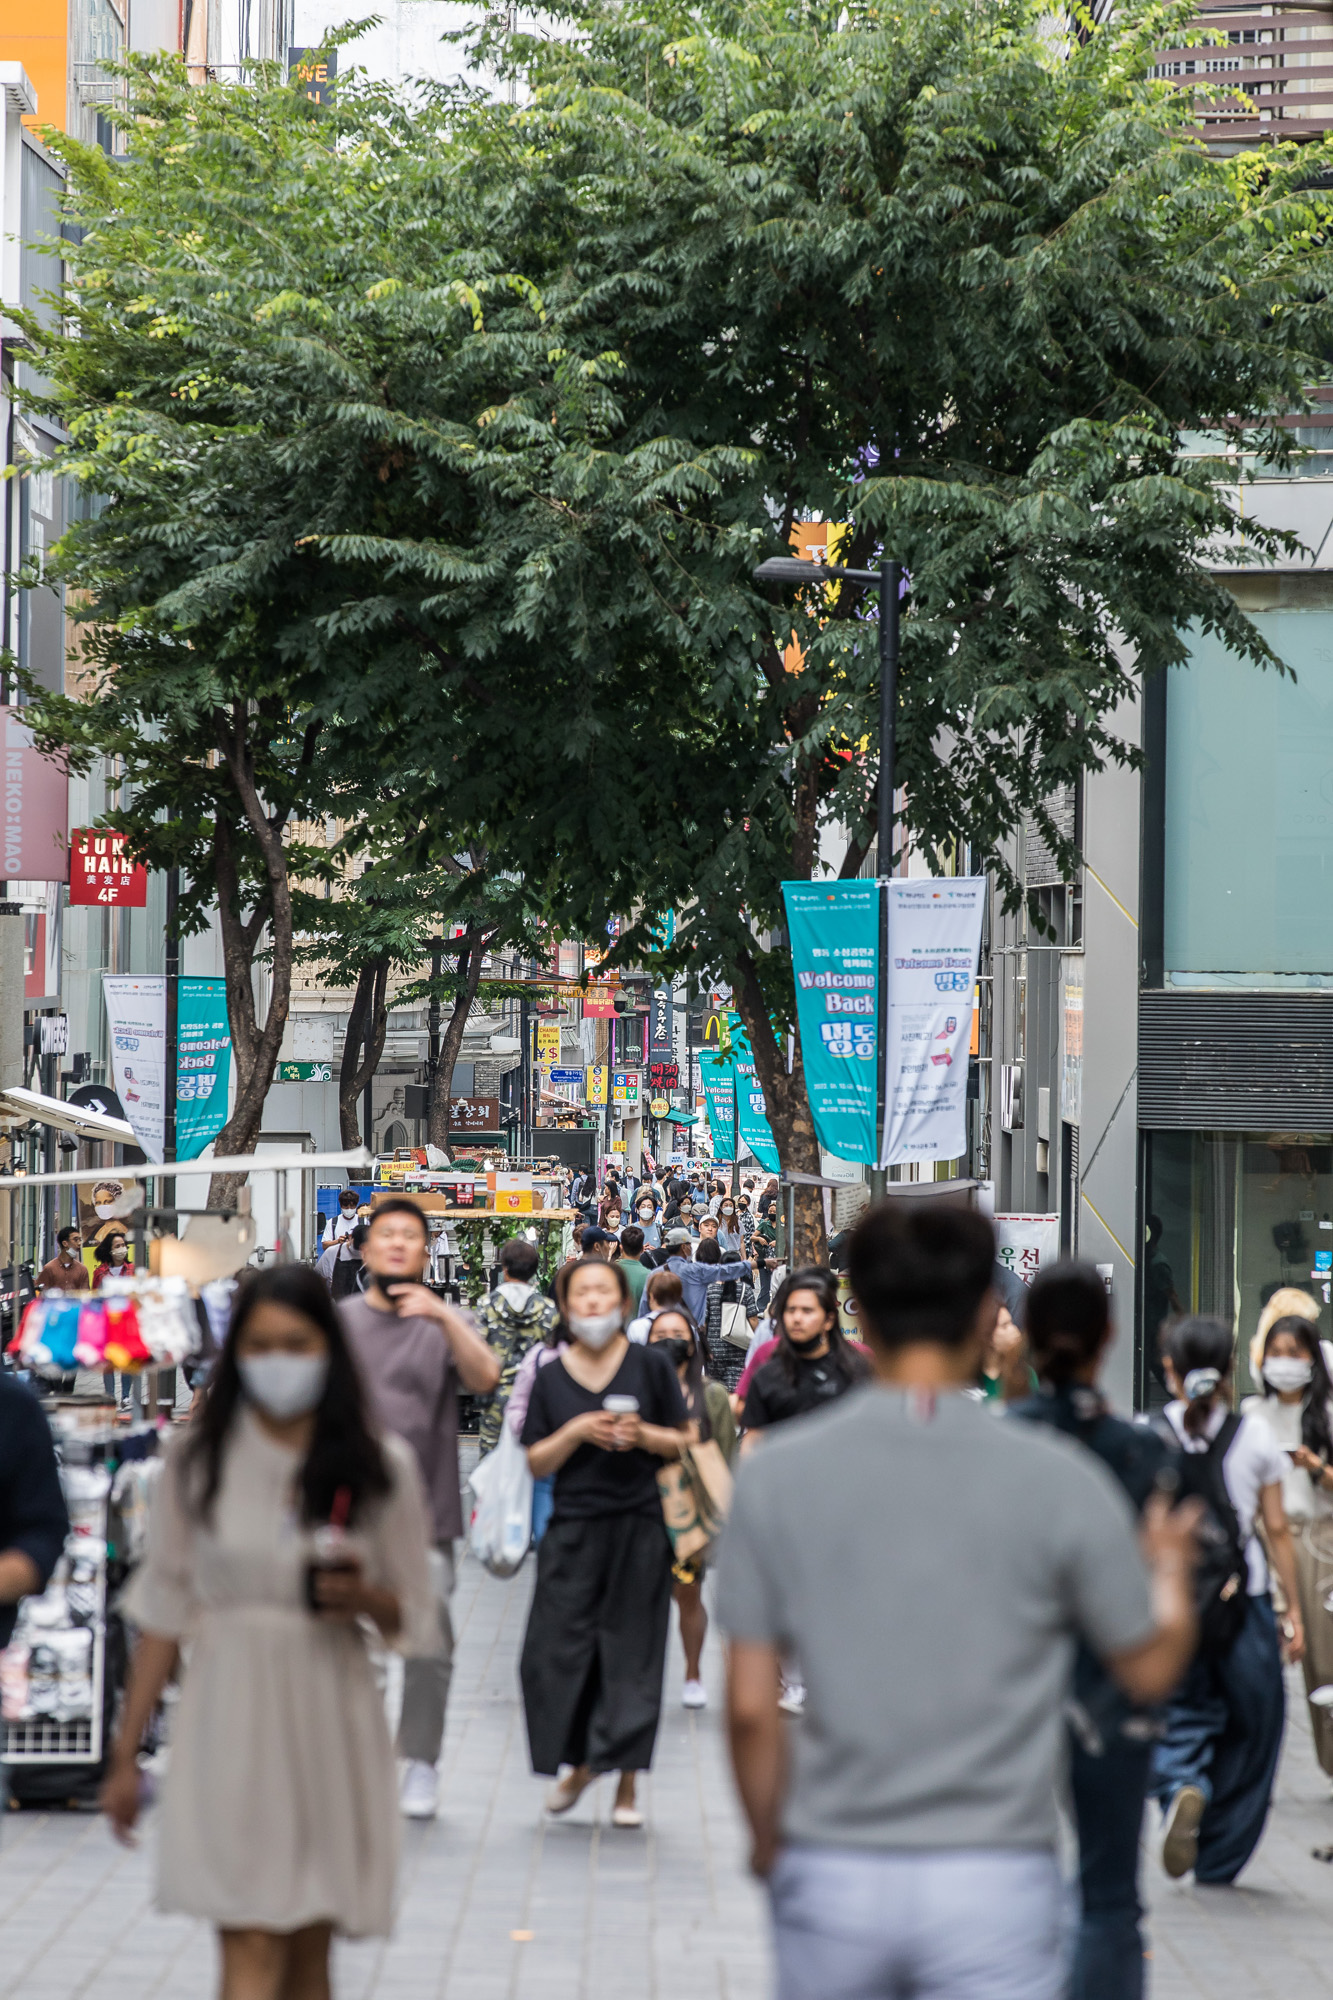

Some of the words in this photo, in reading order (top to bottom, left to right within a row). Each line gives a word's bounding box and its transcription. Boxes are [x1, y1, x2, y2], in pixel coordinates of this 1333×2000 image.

[296, 64, 328, 82] WE
[78, 838, 135, 855] JUN
[84, 857, 133, 874] HAIR
[87, 875, 131, 886] 美发店
[97, 888, 119, 902] 4F
[895, 959, 943, 969] Welcome
[944, 957, 972, 968] Back
[798, 971, 876, 989] Welcome
[935, 972, 970, 992] 명동
[825, 993, 875, 1014] Back
[653, 990, 669, 1041] 목우촌
[819, 1020, 877, 1060] 명동
[549, 1047, 558, 1059] $
[617, 1076, 625, 1086] $
[628, 1077, 637, 1086] 元
[616, 1088, 624, 1098] €
[628, 1089, 636, 1098] ¥
[714, 1095, 733, 1104] Back
[749, 1093, 767, 1114] 명
